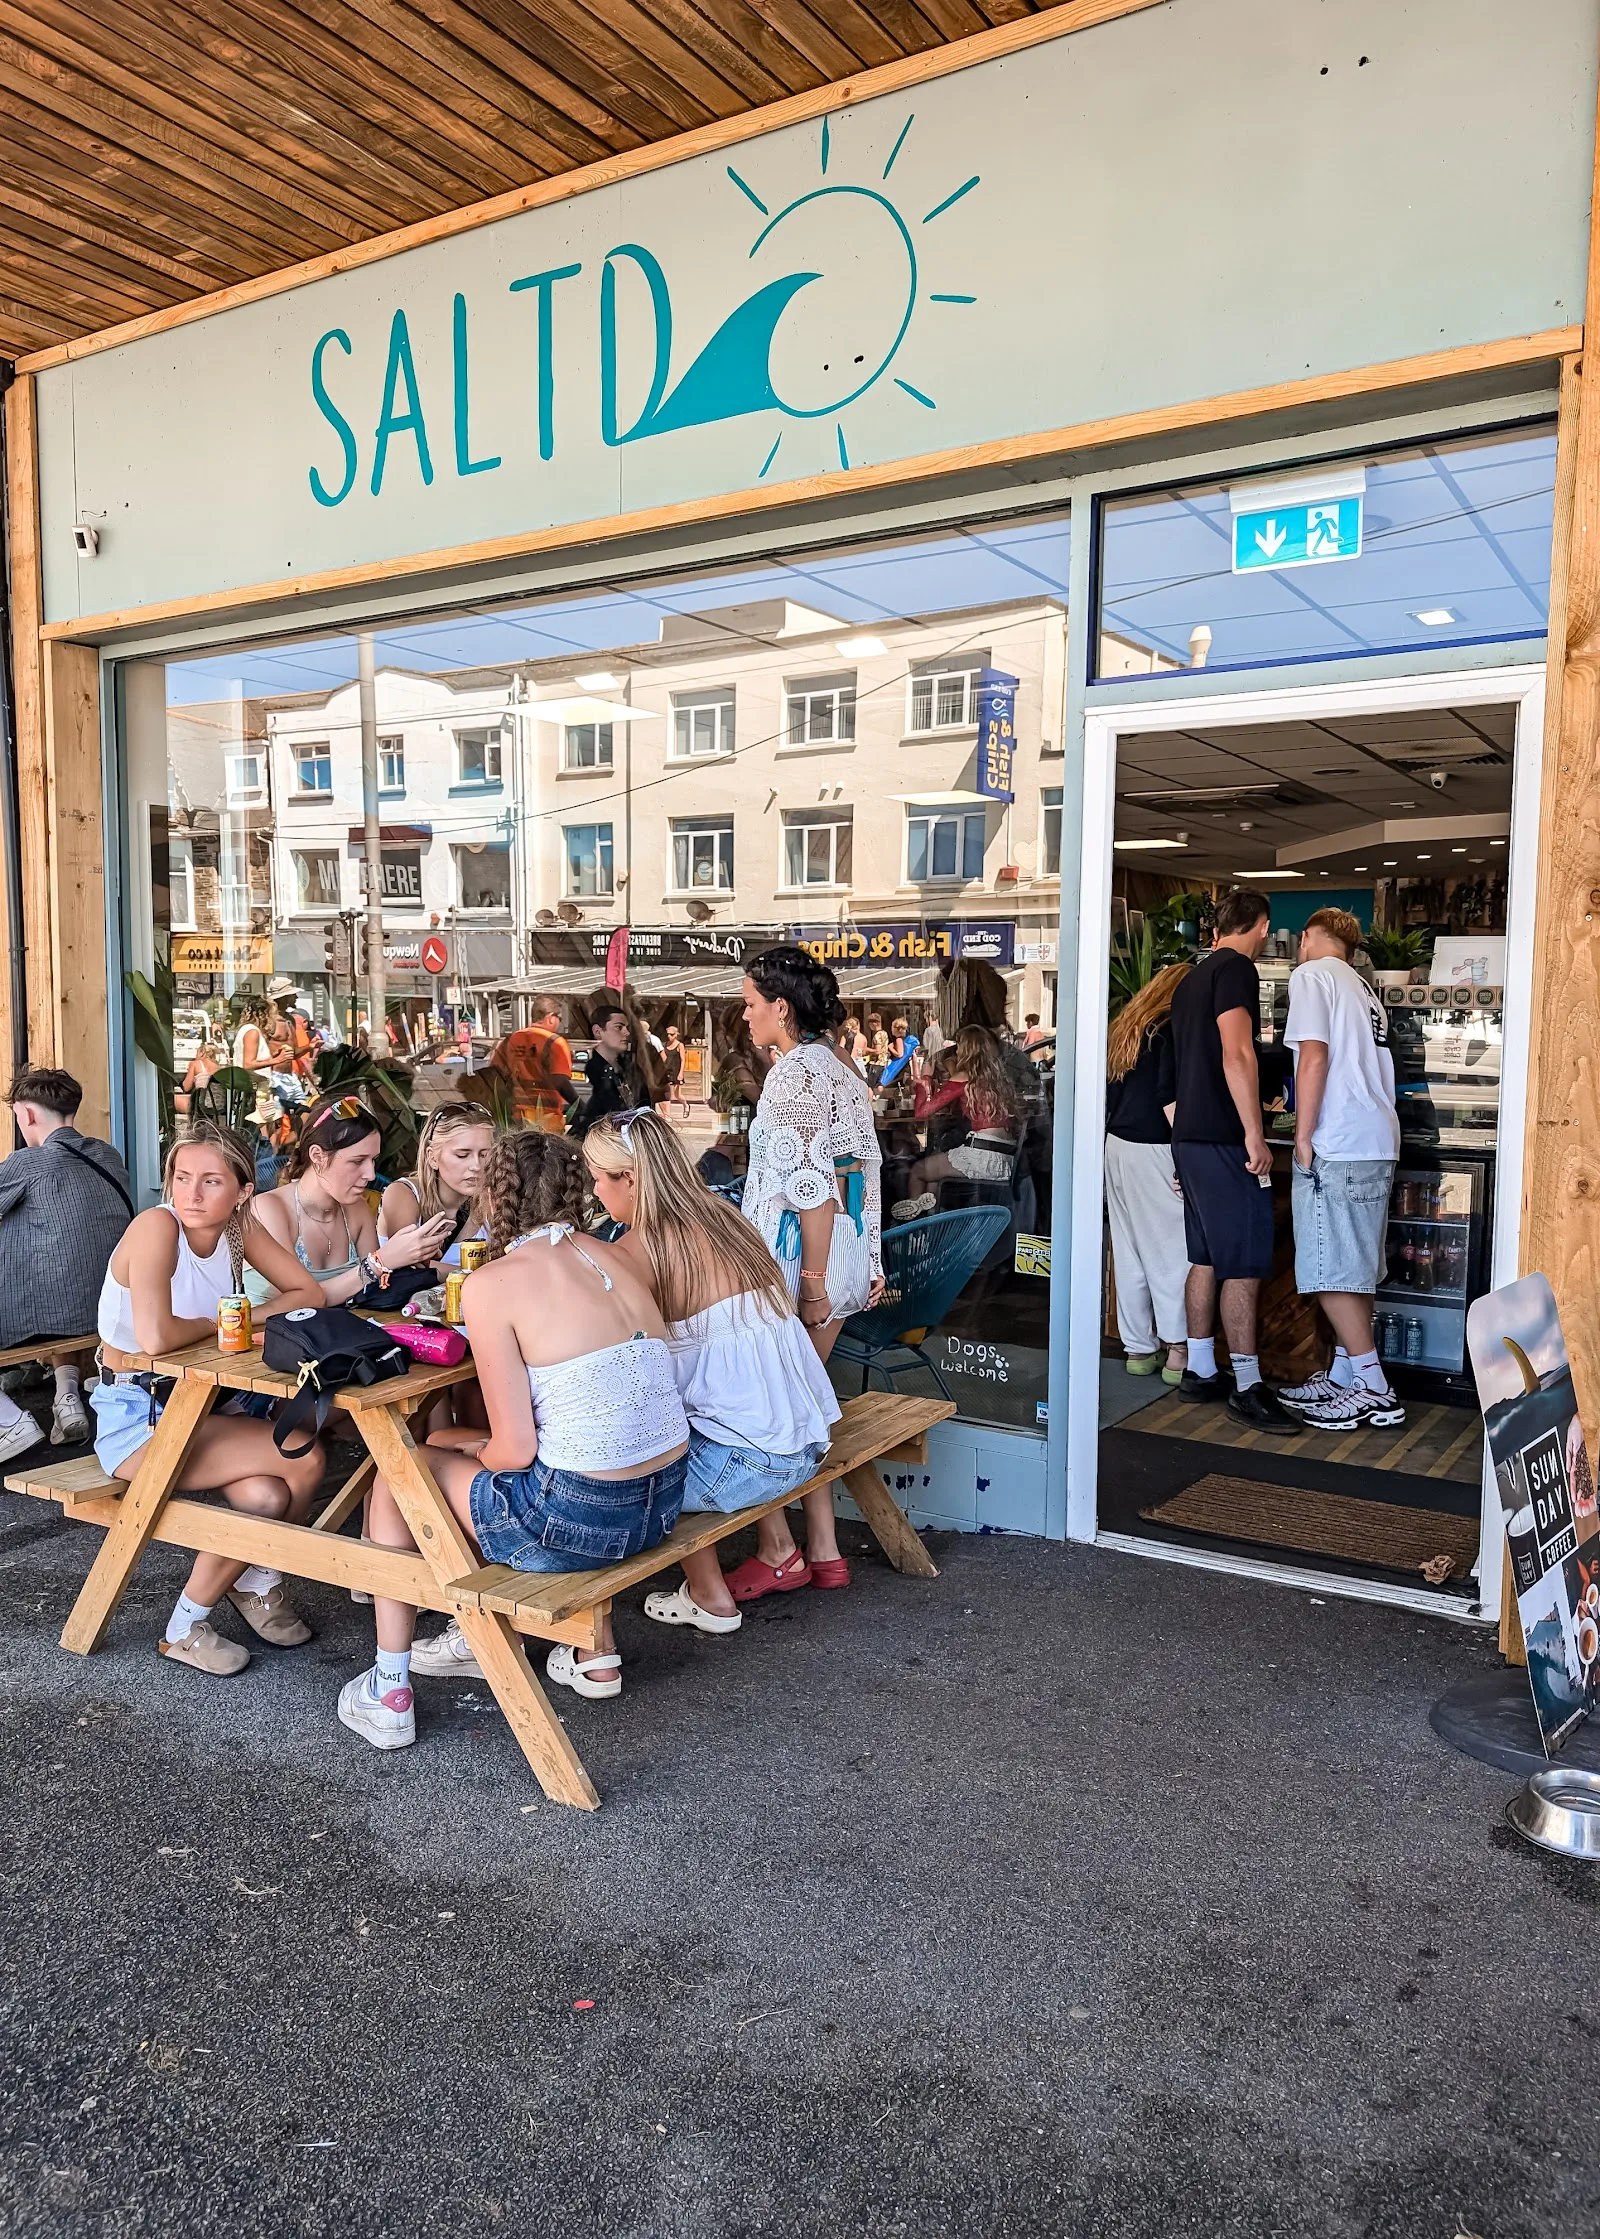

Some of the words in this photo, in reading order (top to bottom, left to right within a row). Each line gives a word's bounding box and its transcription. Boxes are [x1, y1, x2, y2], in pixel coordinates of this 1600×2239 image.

[309, 243, 672, 507] SALTD
[372, 863, 421, 895] HERE
[468, 1249, 487, 1259] drip
[948, 1336, 996, 1363] Dogs
[940, 1359, 1008, 1382] welcome
[1537, 1484, 1564, 1530] DAY
[1546, 1532, 1572, 1566] COFFEE
[1522, 1569, 1533, 1581] DAY
